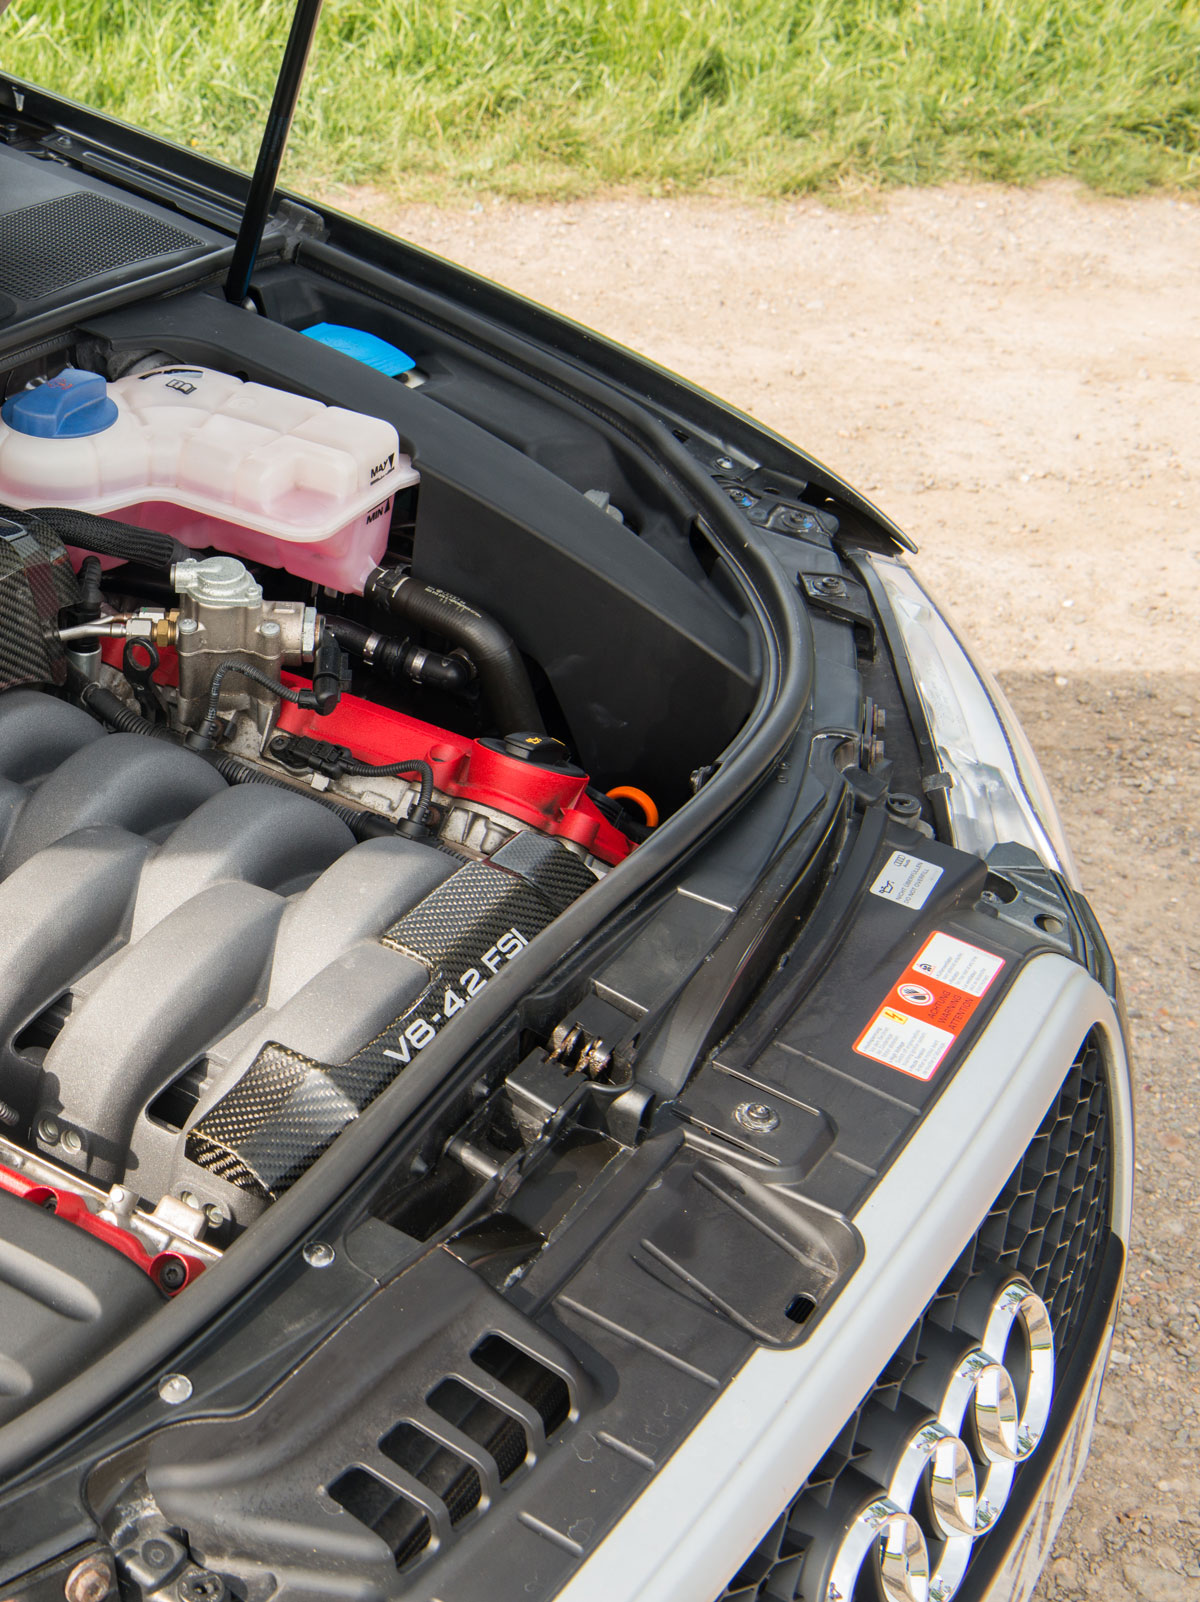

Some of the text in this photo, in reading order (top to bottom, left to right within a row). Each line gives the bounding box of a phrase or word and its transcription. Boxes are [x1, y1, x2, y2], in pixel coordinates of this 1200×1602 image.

[366, 507, 384, 525] MIN
[481, 928, 529, 974] FSI
[927, 989, 951, 1019] ACHTUNG
[937, 994, 962, 1024] WARNING
[947, 997, 974, 1030] ATTENTION
